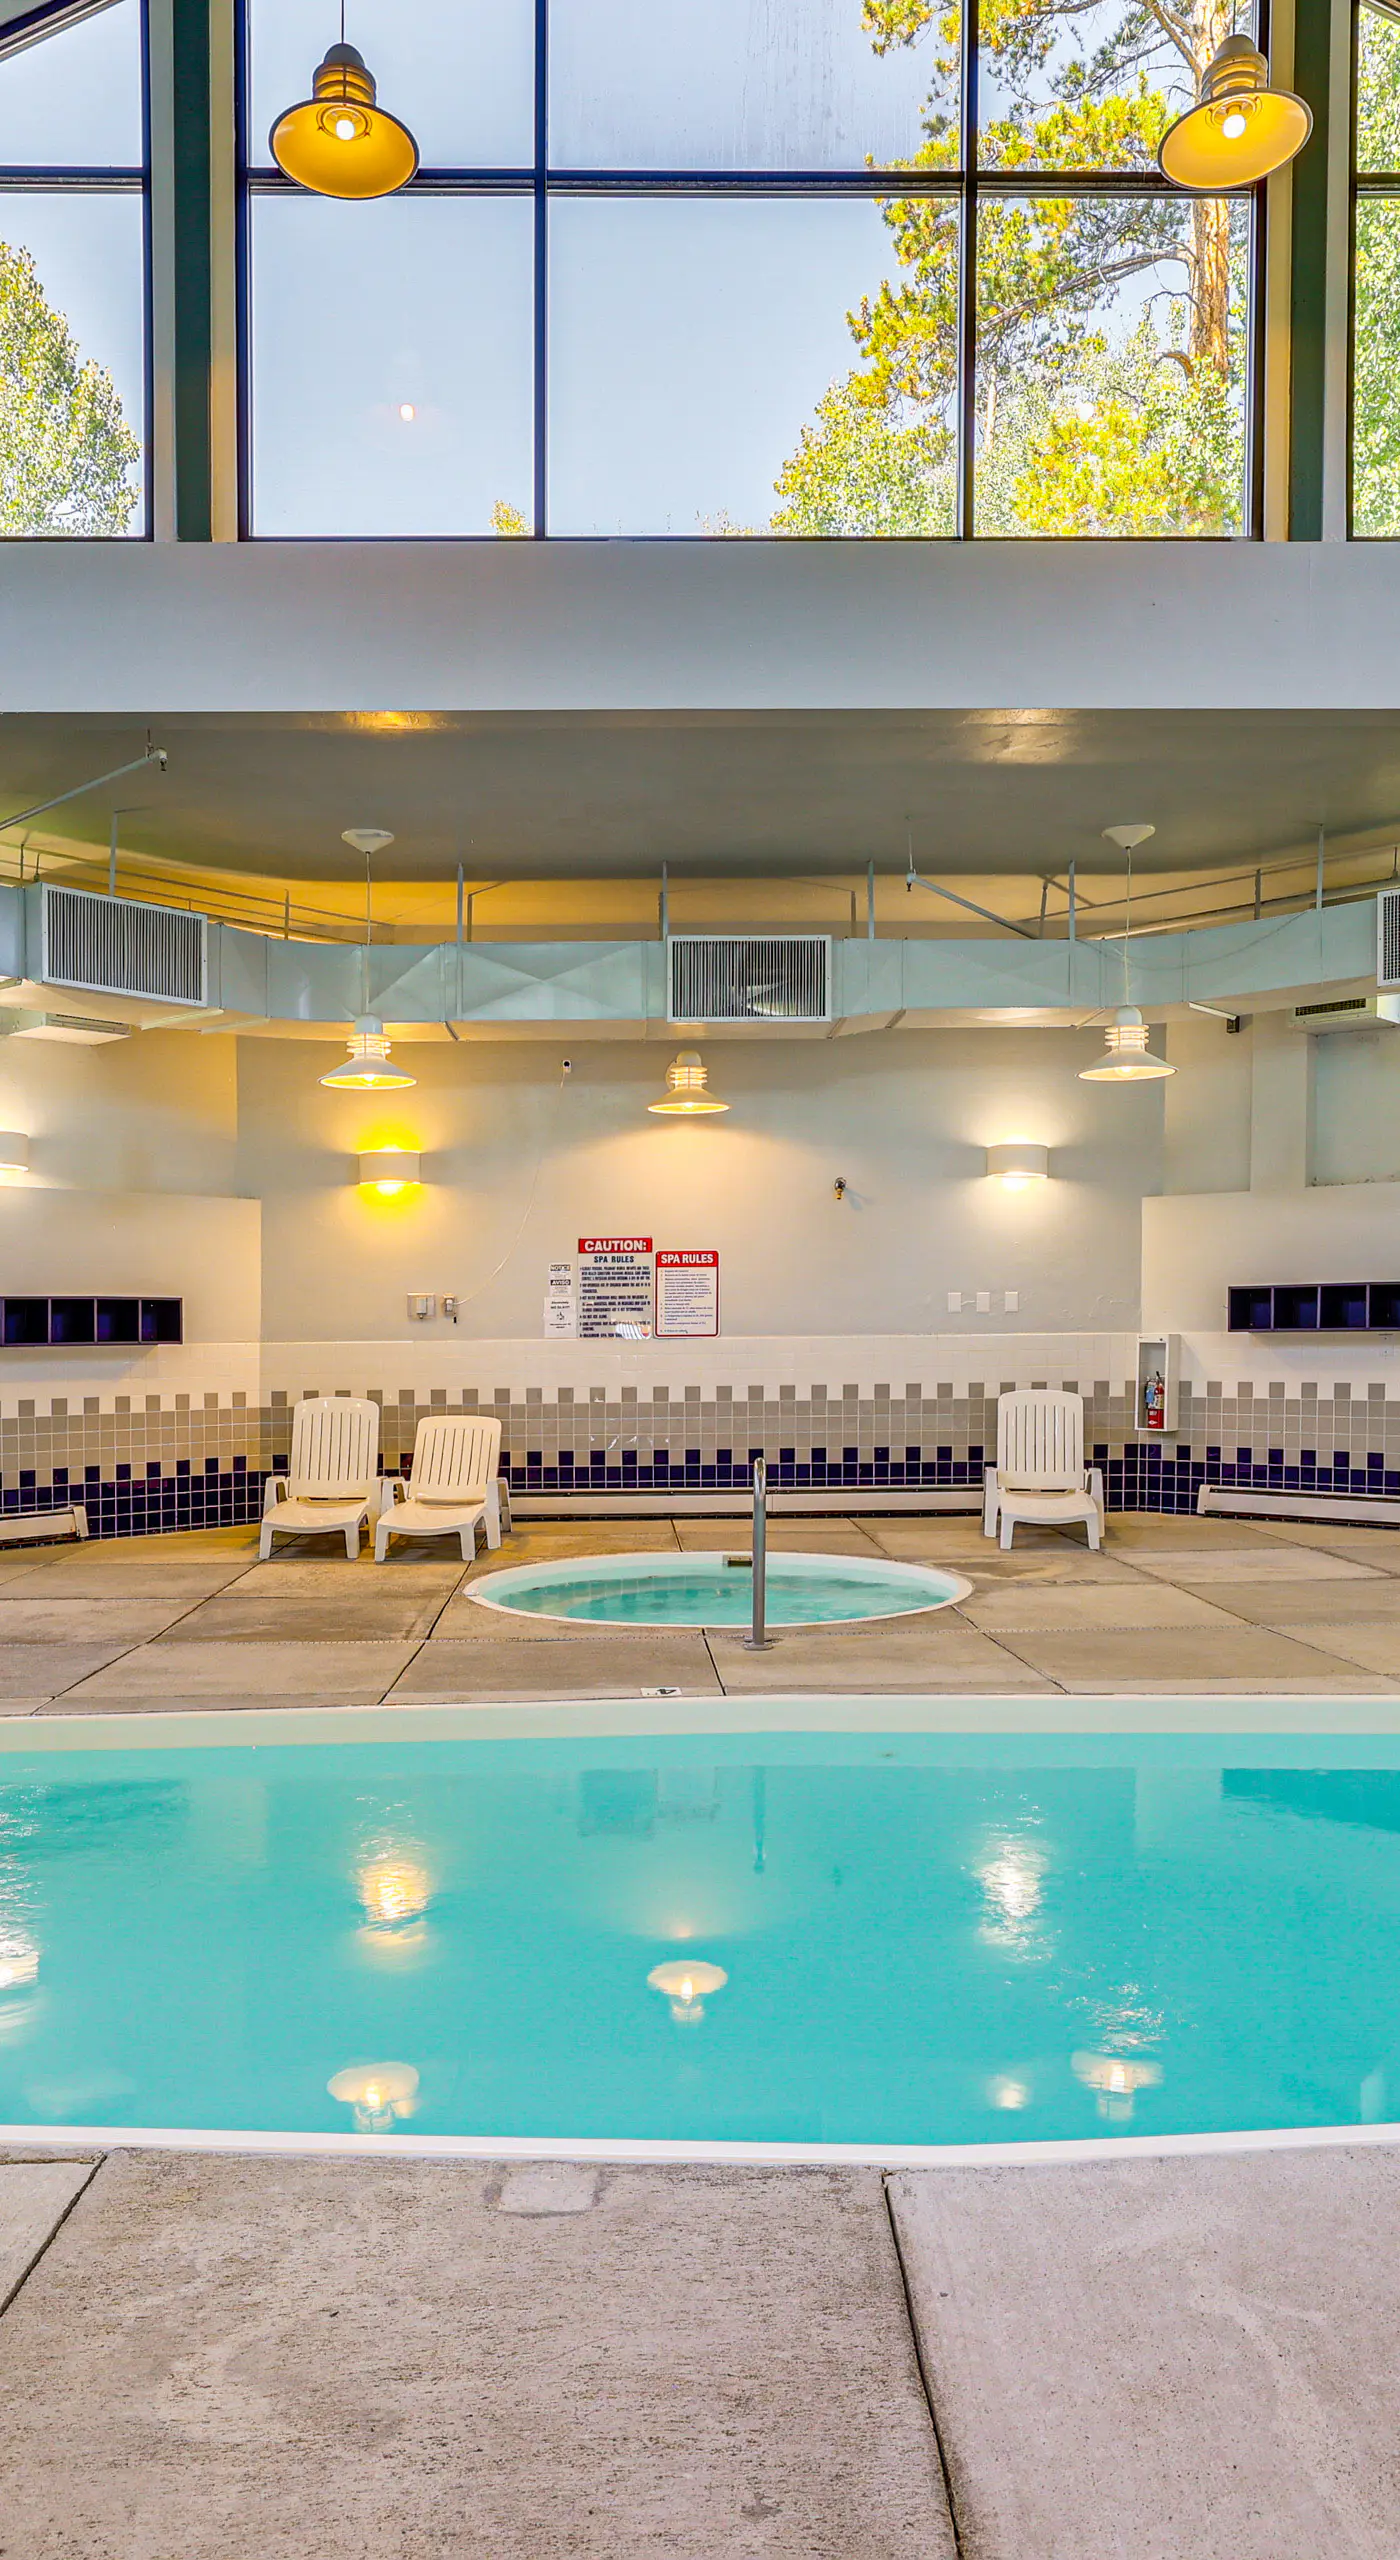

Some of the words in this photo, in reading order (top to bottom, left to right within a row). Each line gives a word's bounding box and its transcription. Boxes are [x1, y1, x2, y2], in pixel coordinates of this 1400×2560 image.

[584, 1240, 647, 1251] CAUTION:
[593, 1255, 608, 1263] SPA
[611, 1255, 635, 1263] RULES
[661, 1254, 680, 1264] SPA
[682, 1254, 714, 1264] RULES
